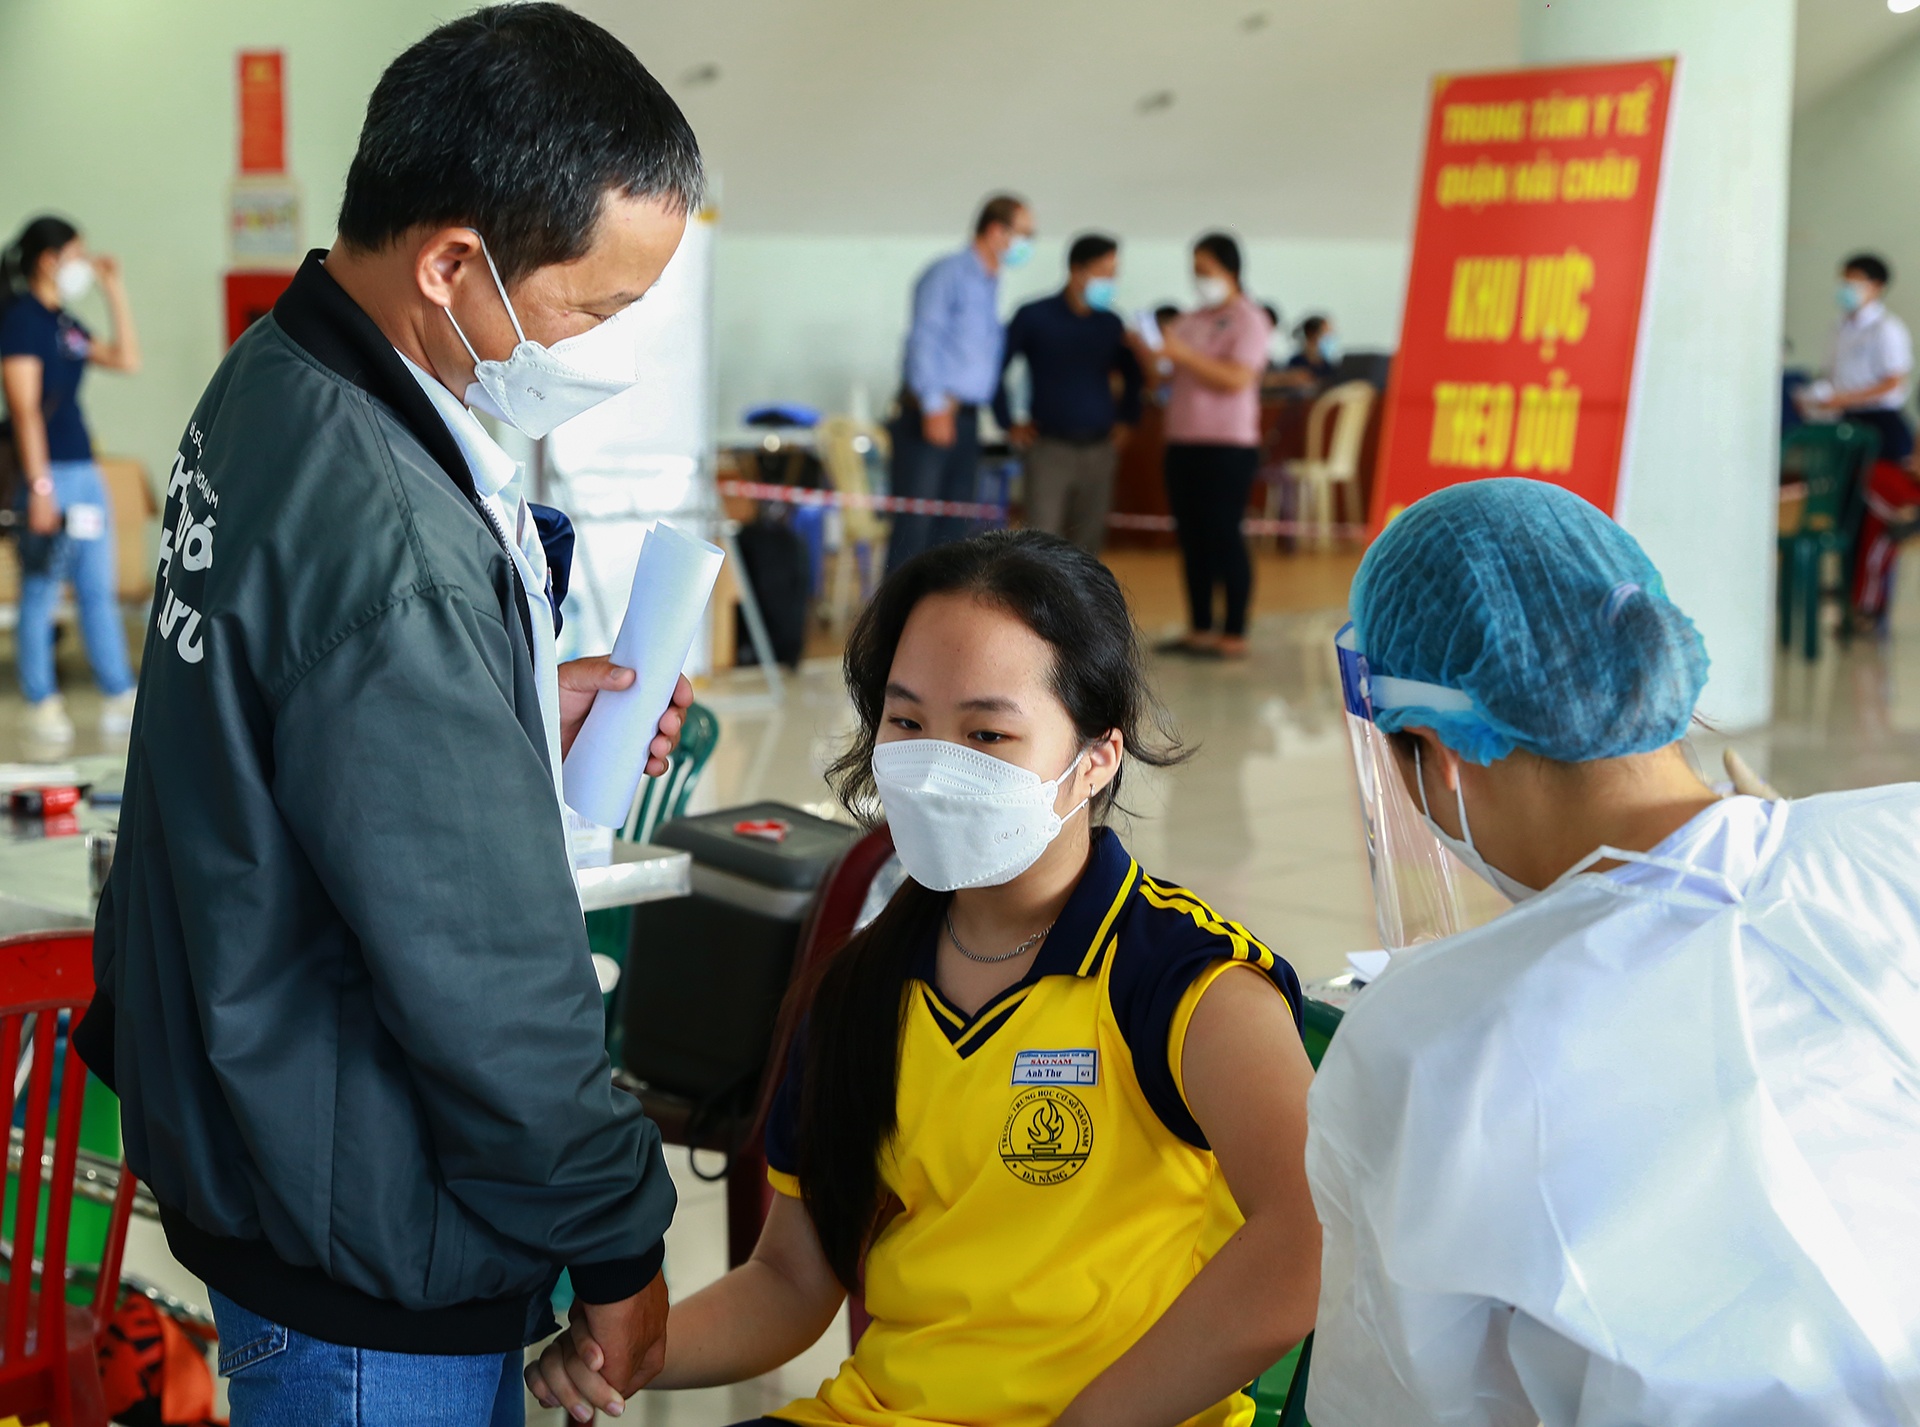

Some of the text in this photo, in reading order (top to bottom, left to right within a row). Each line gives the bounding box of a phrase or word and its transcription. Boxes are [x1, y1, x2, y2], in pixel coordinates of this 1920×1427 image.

[1442, 102, 1525, 144] TRUNG
[1593, 94, 1616, 138] Y
[1615, 80, 1654, 137] TẾ
[1436, 156, 1507, 212] QUẬN
[1446, 246, 1595, 362] KHU VỰC
[1428, 380, 1515, 468] THEO
[1012, 1092, 1036, 1112] TRUNG
[1045, 1069, 1063, 1078] Thư
